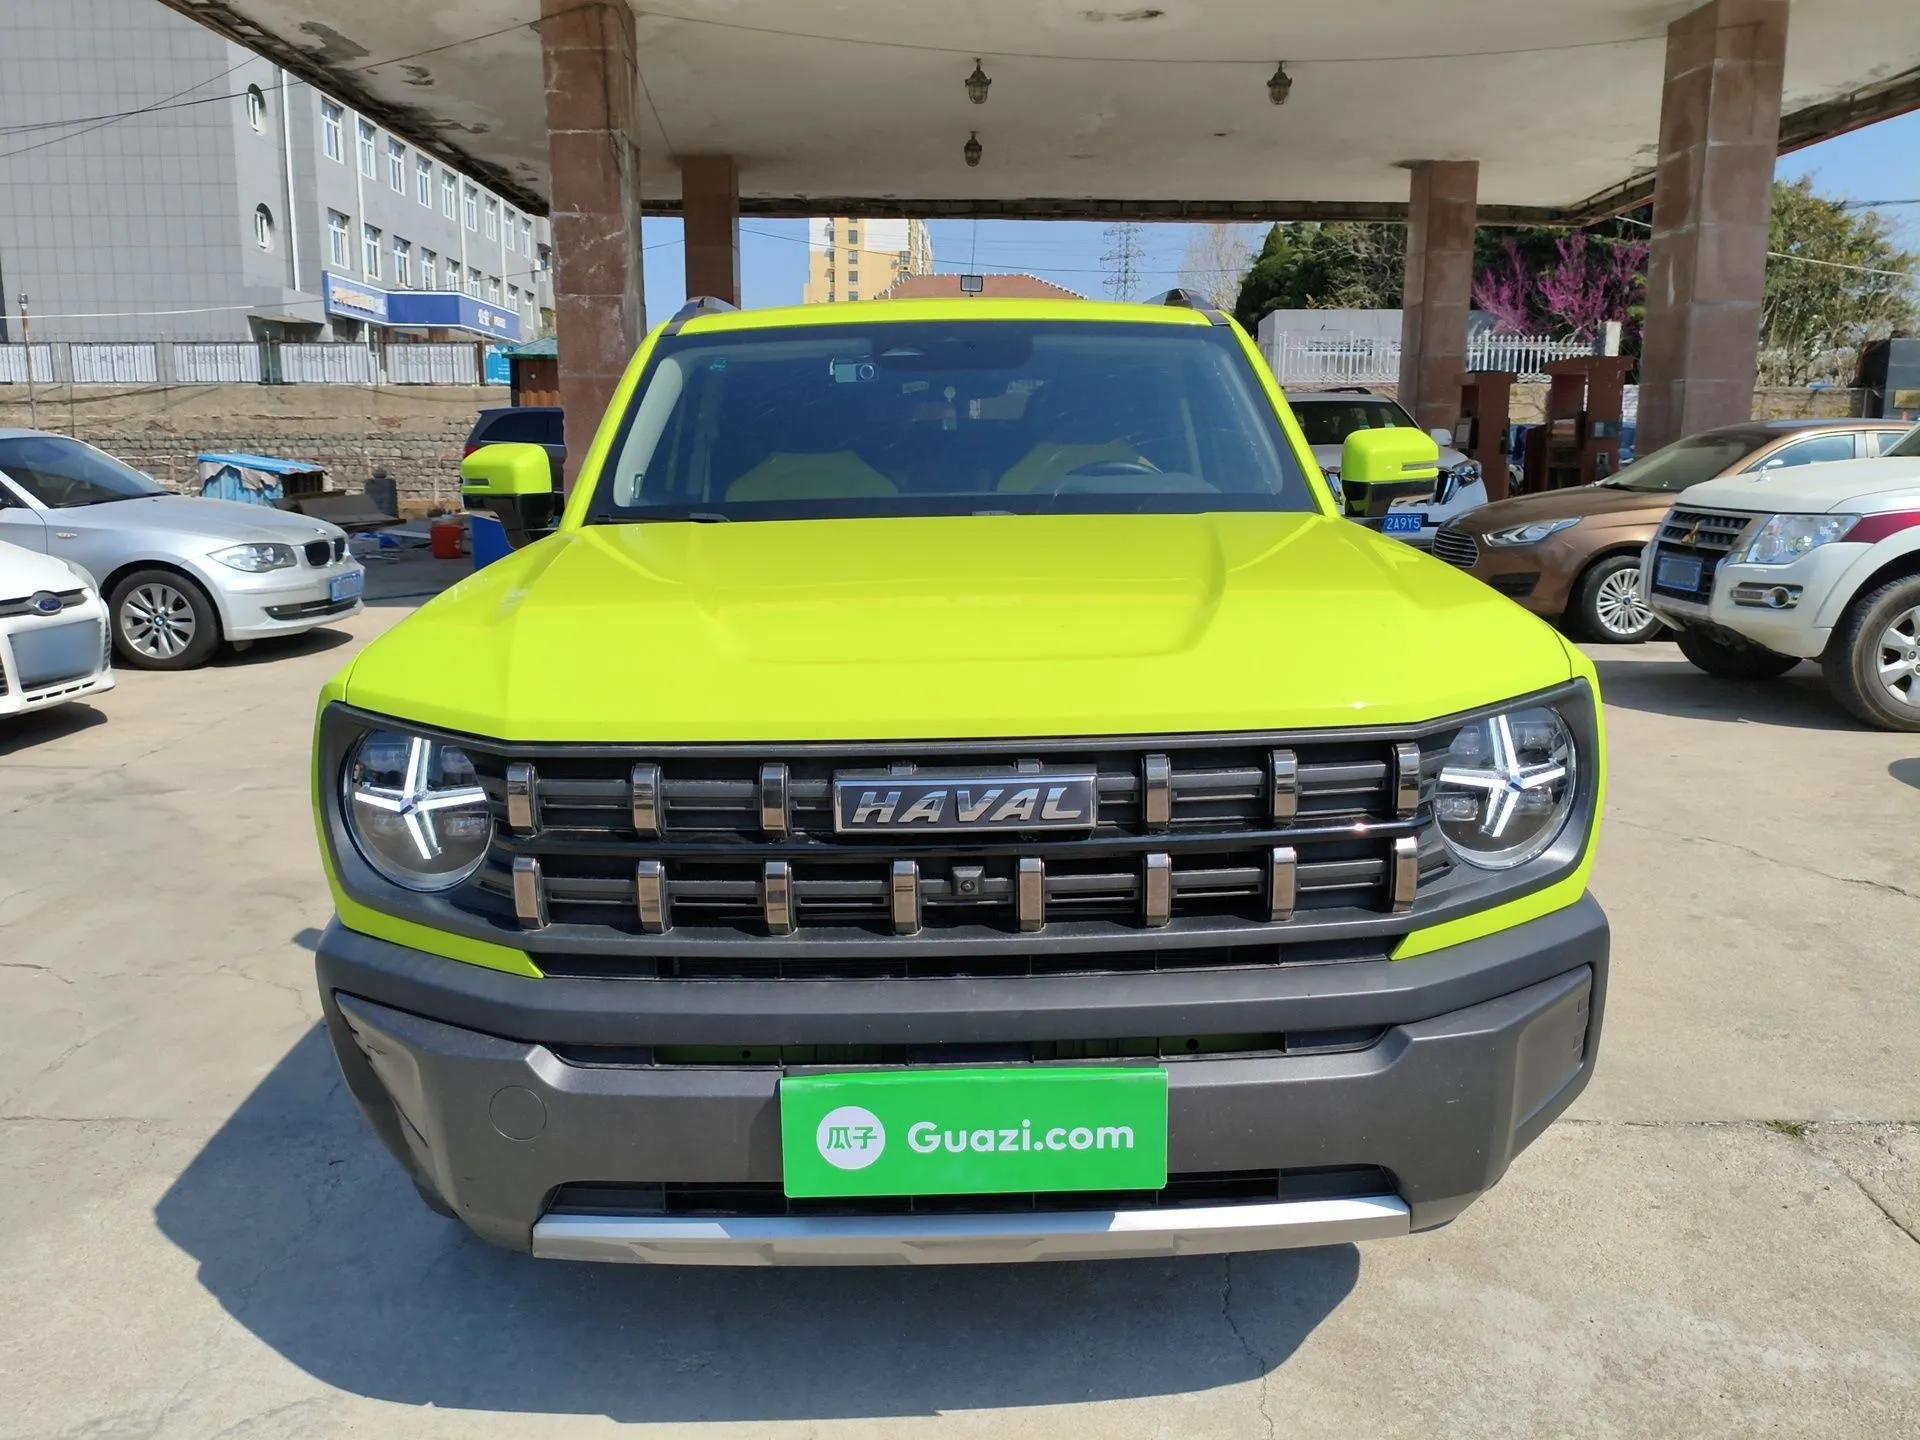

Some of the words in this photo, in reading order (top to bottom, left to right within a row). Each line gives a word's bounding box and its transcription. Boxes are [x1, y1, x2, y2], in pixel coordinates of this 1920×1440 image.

[1387, 517, 1420, 530] 2A9Y5
[851, 786, 1081, 824] HAVAL
[826, 1126, 878, 1150] 瓜子
[907, 1119, 1134, 1153] Guazi.com
